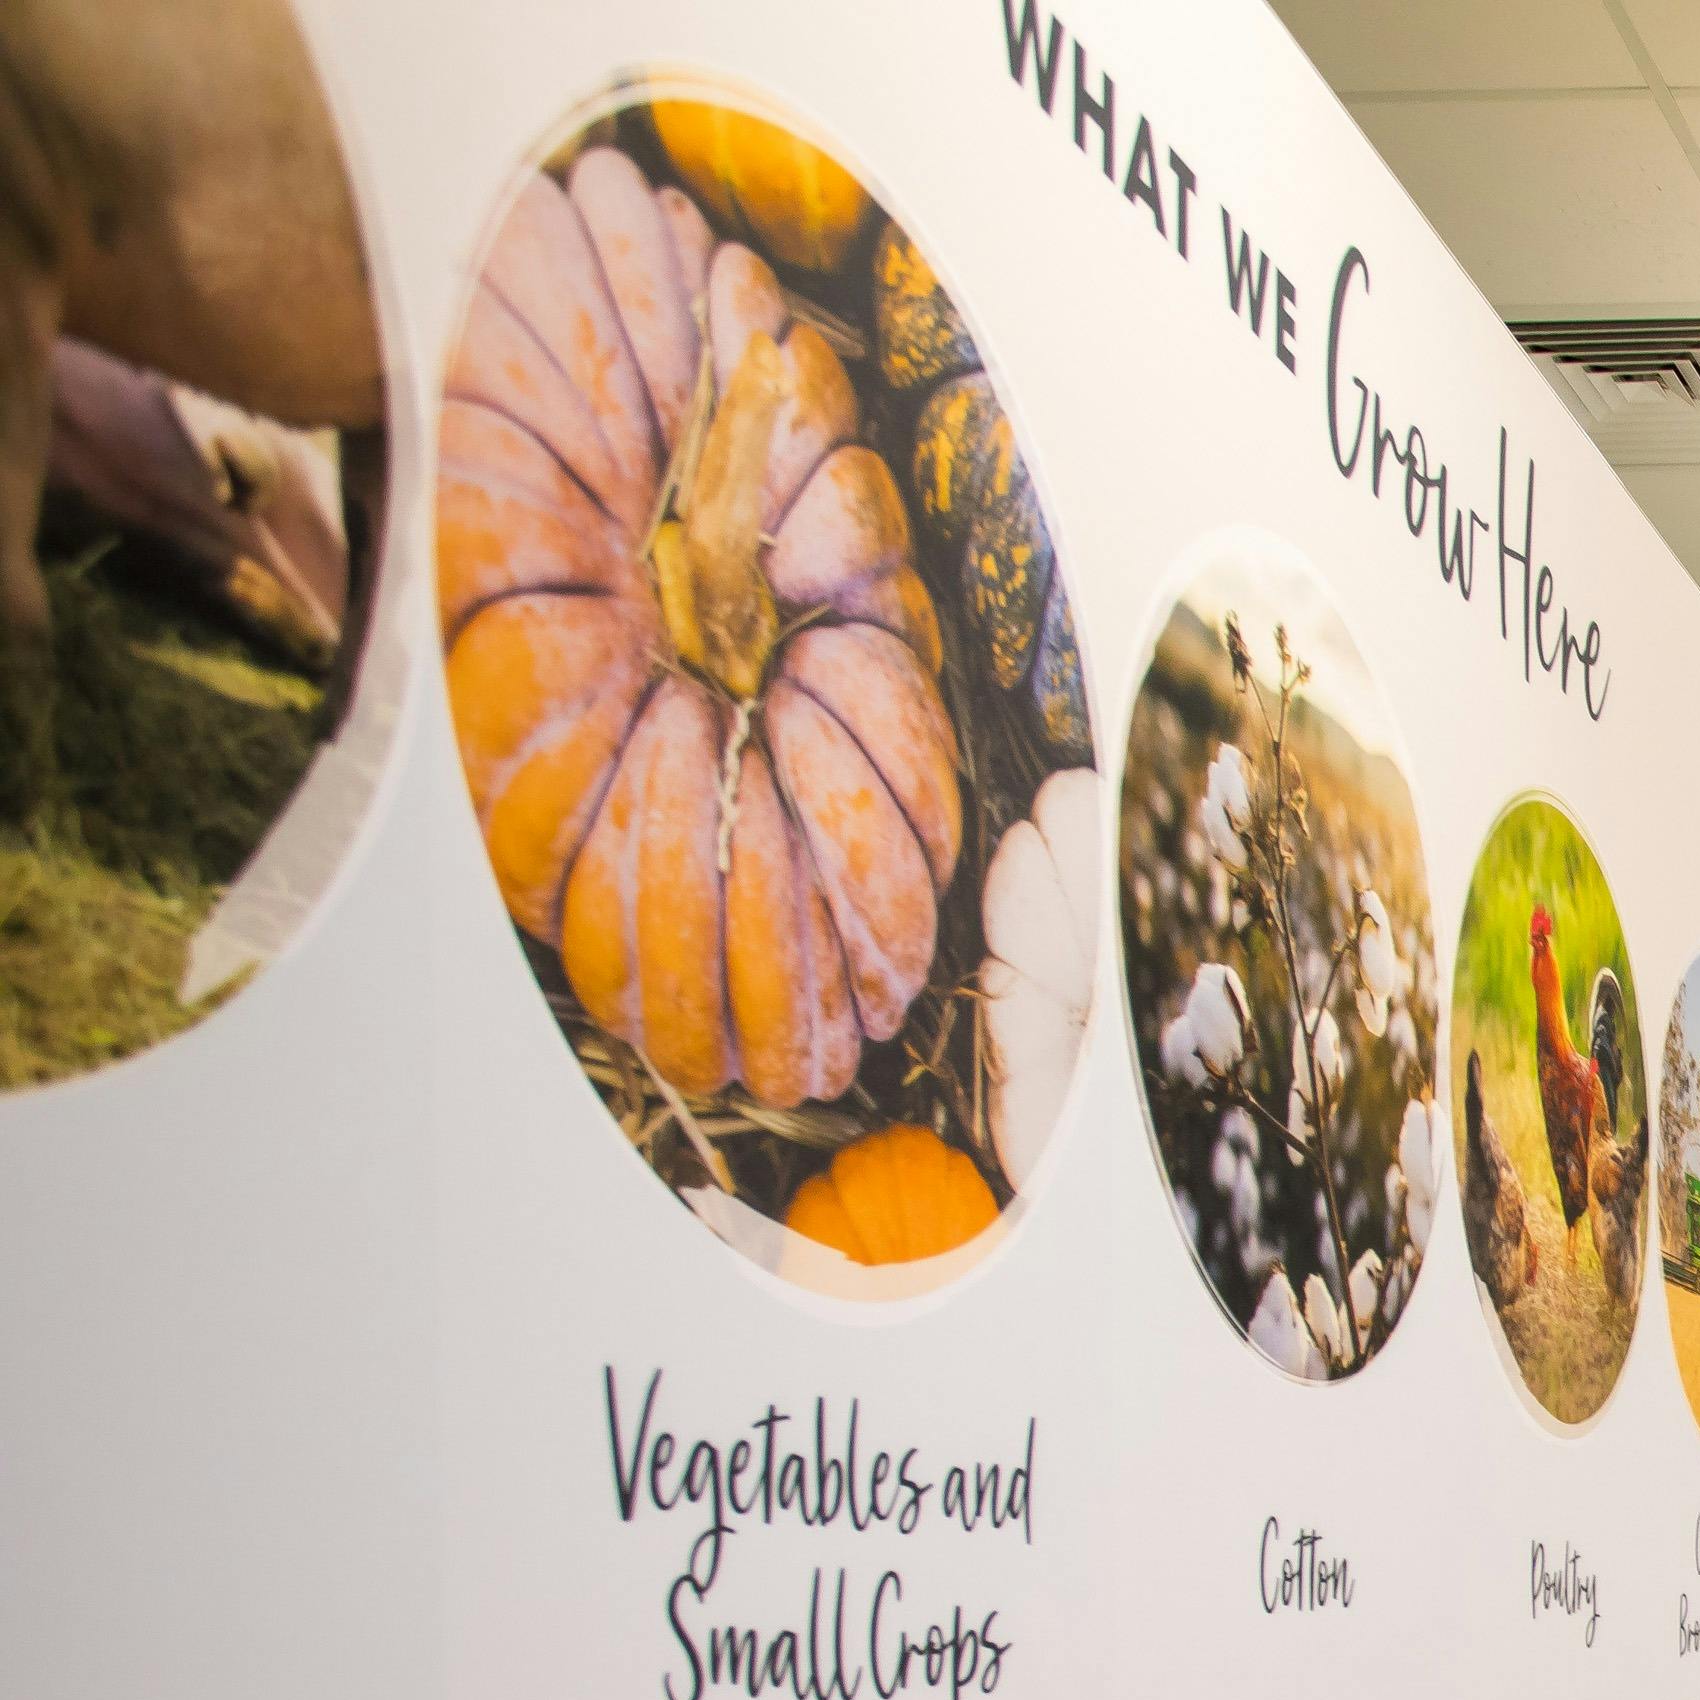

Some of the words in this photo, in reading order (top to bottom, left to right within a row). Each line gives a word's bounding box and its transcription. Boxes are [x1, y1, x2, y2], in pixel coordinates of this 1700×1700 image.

[1003, 0, 1198, 262] WHAT
[1221, 206, 1296, 376] WE
[1327, 246, 1489, 601] Grow
[1498, 426, 1609, 721] Here
[605, 1364, 933, 1602] Vegetables
[942, 1418, 1035, 1544] and
[1260, 1516, 1352, 1613] Cotton
[1531, 1540, 1600, 1648] Poultry
